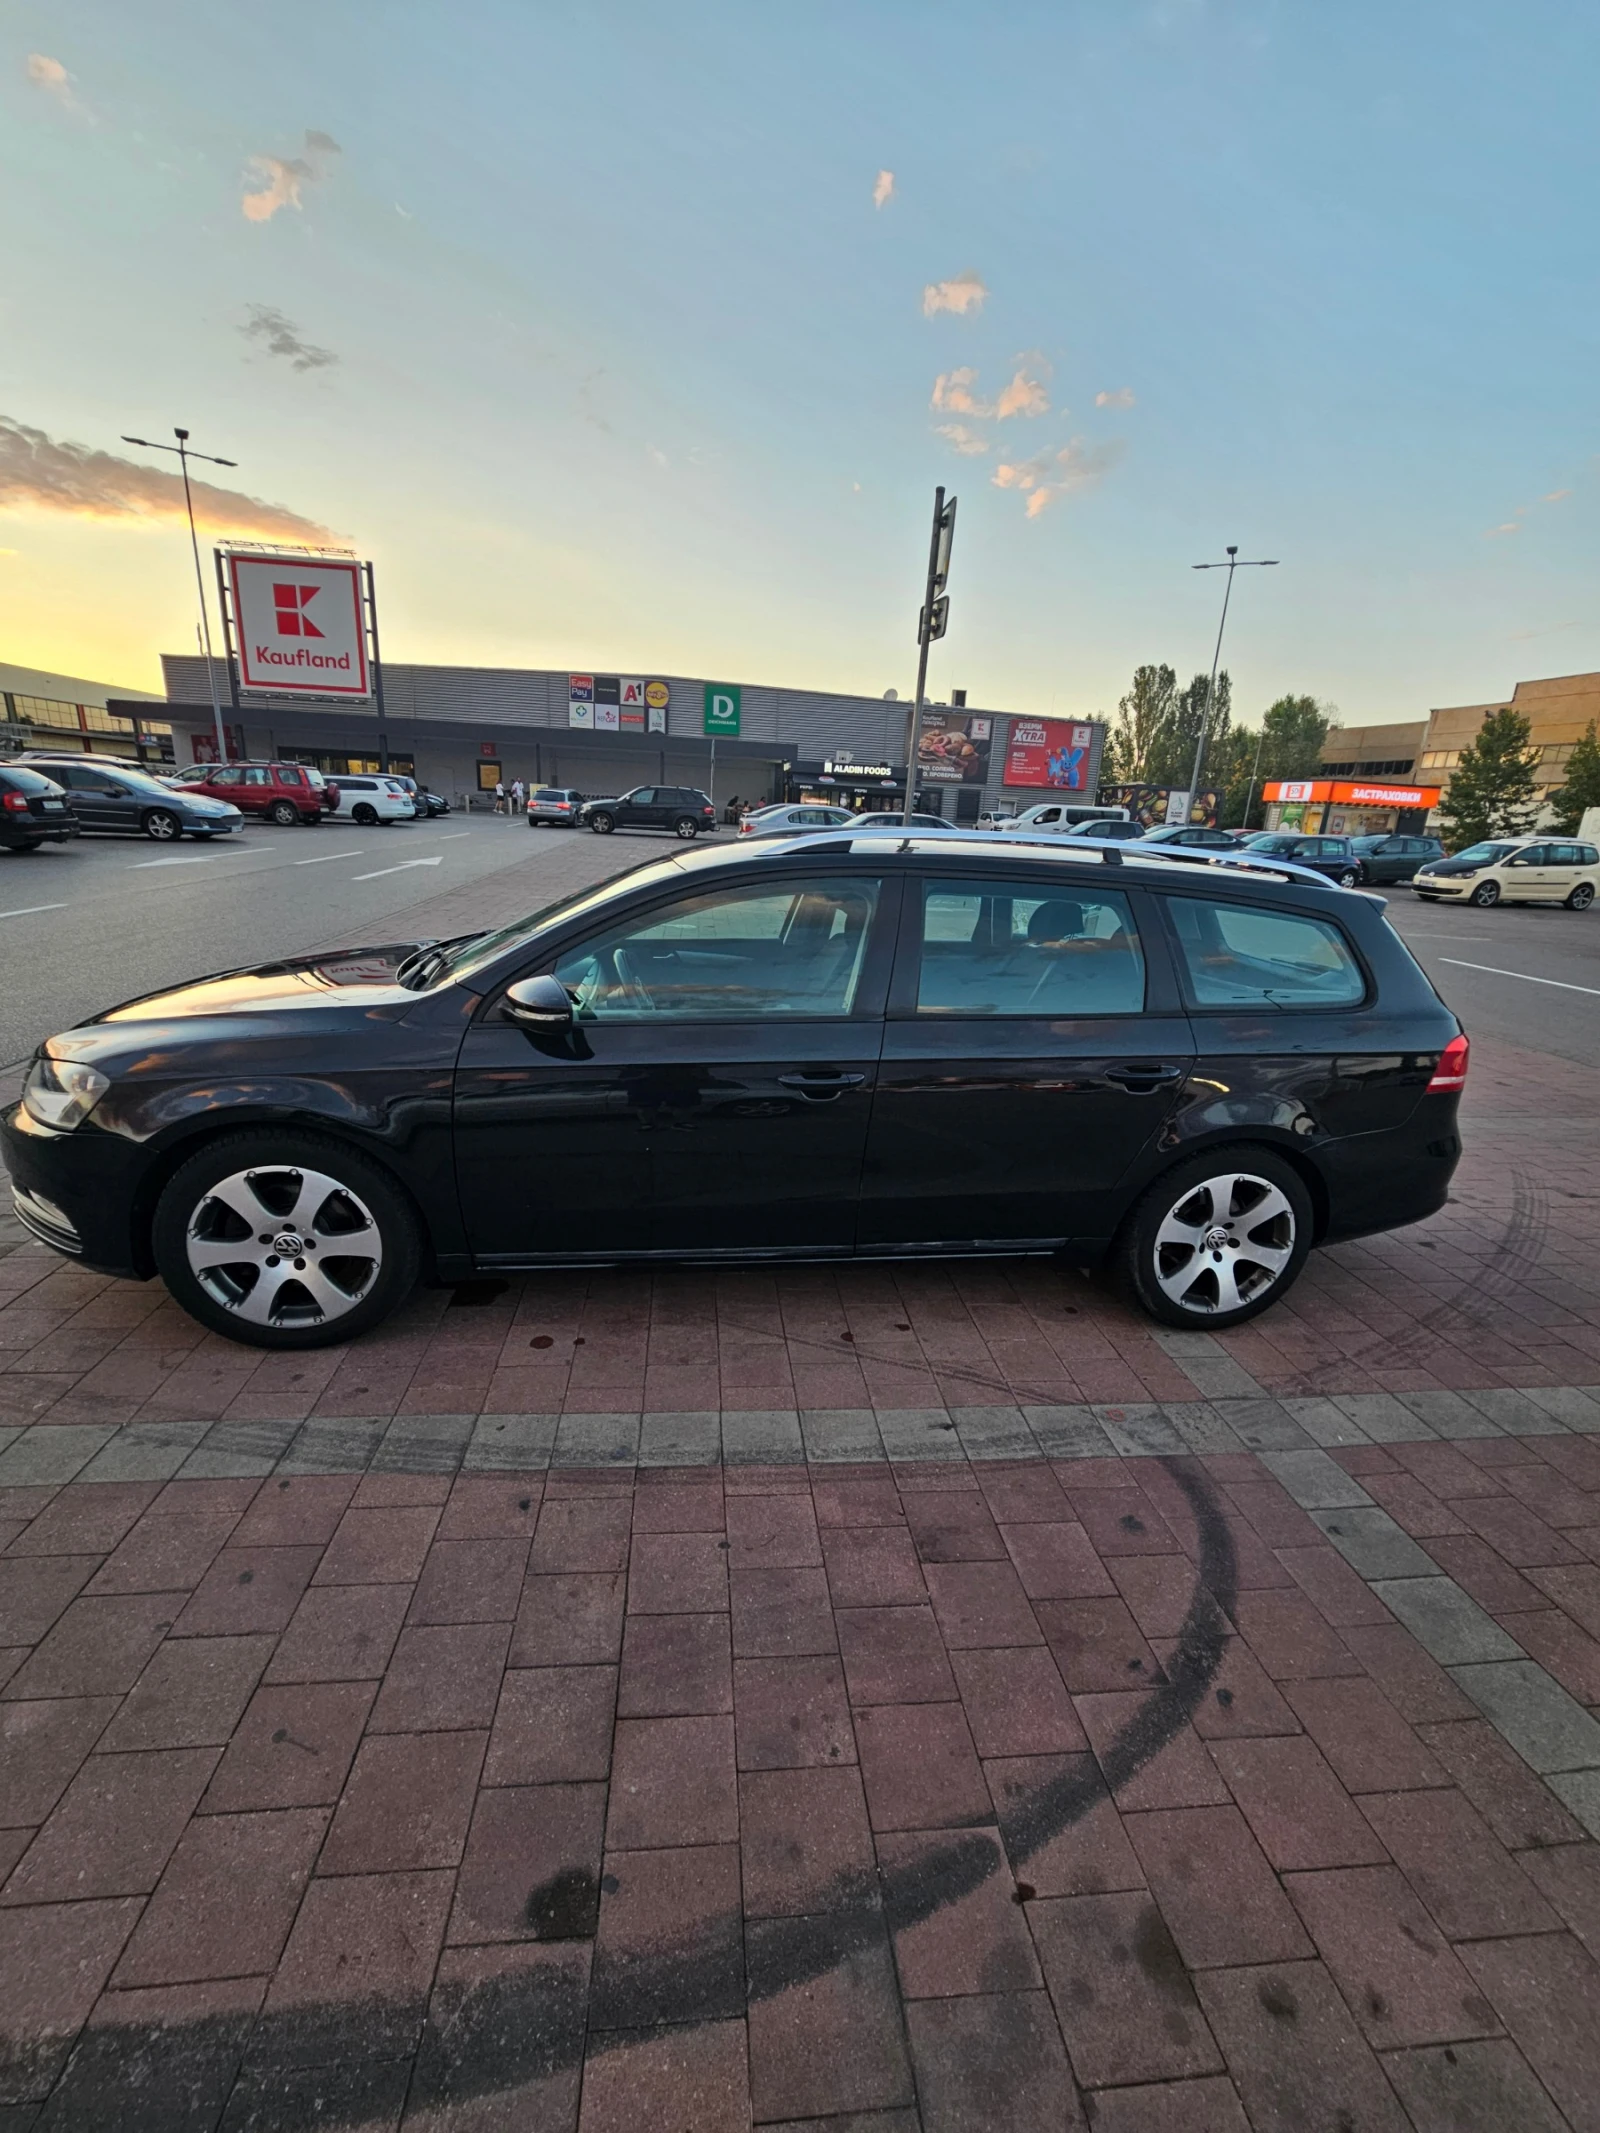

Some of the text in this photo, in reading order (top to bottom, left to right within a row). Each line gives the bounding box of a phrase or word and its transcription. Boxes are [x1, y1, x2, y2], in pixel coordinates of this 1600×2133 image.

[256, 645, 350, 670] Kaufland
[571, 678, 592, 689] Easy
[571, 688, 588, 698] Pay
[623, 683, 642, 702] A1
[713, 695, 734, 718] D
[1018, 722, 1043, 730] ВЗЕМИ
[1012, 729, 1046, 743] XTRA
[833, 764, 892, 776] ALADIN FOODS
[1352, 787, 1422, 803] ЗАСТРАХОВКИ
